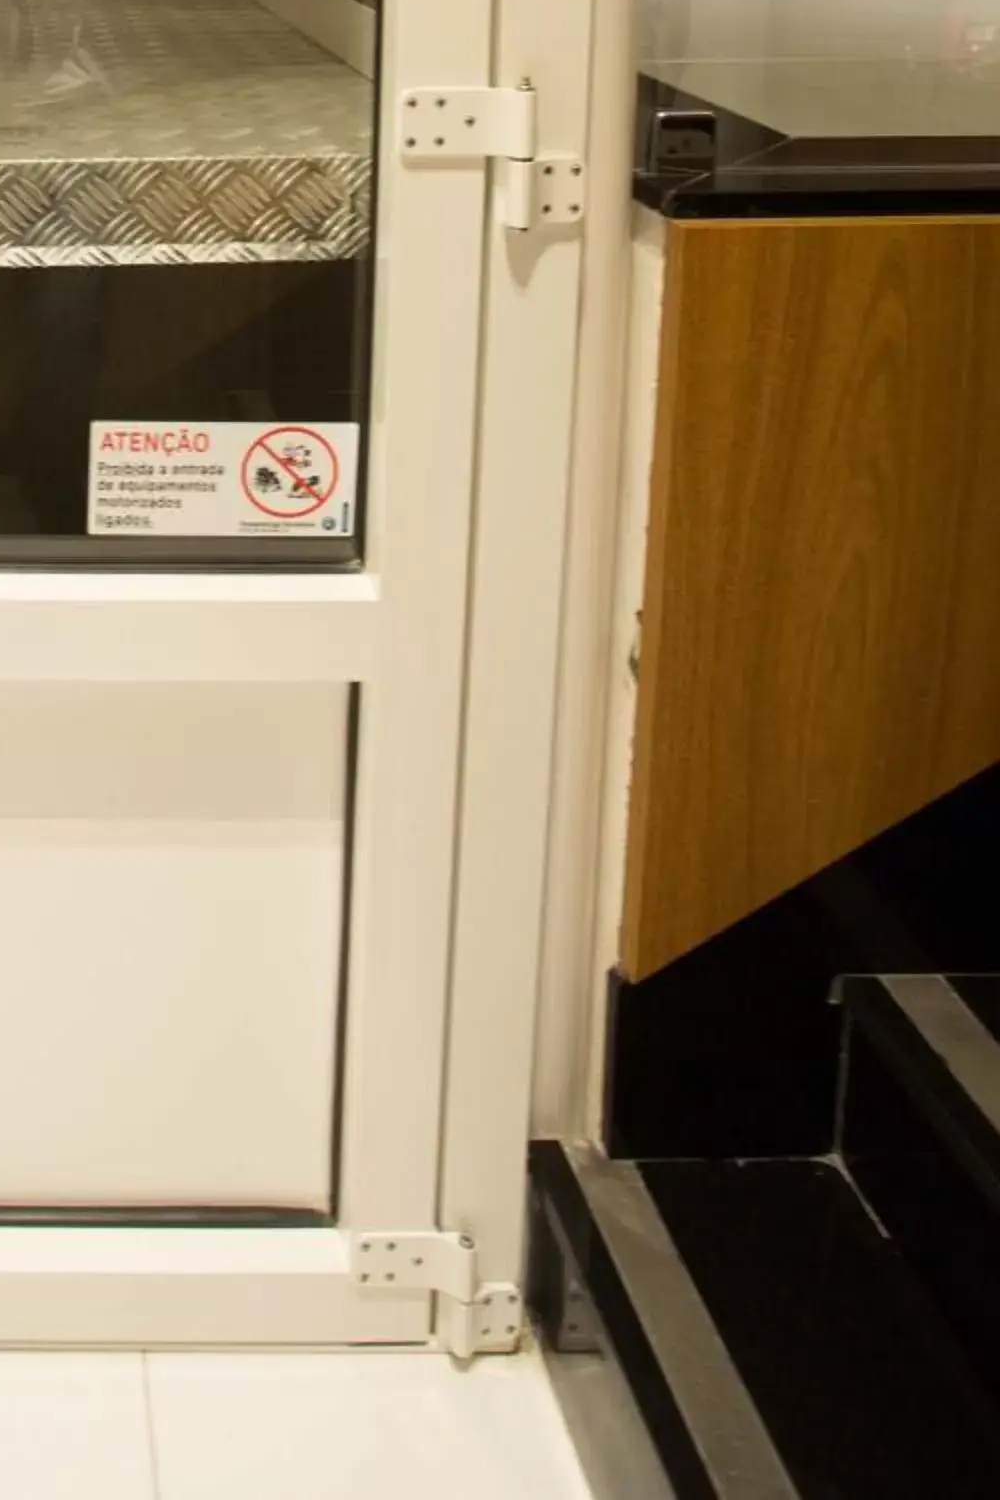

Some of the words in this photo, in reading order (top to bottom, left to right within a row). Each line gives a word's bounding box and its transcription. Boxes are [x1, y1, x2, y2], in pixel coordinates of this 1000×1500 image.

[100, 429, 210, 456] ATENÇÃO
[97, 462, 154, 475] Proibida
[159, 465, 167, 475] a
[172, 465, 225, 475] entrada
[97, 480, 113, 491] de
[118, 480, 216, 493] equipamentos
[97, 497, 182, 509] motorizados
